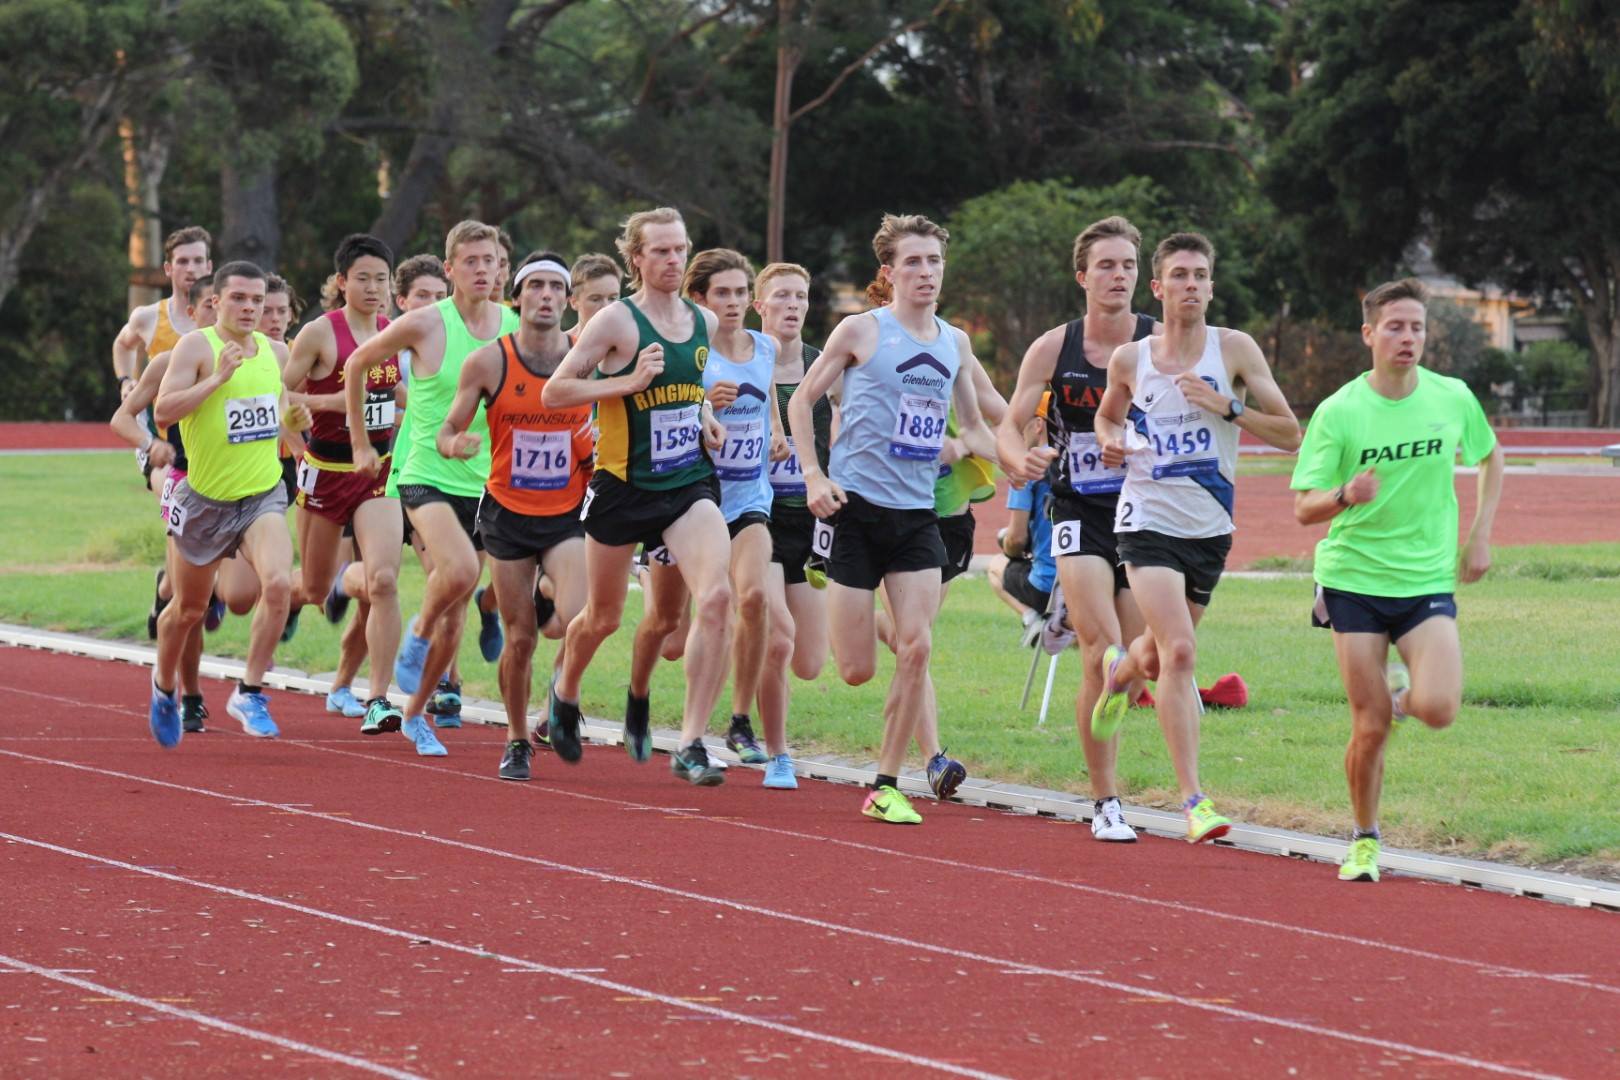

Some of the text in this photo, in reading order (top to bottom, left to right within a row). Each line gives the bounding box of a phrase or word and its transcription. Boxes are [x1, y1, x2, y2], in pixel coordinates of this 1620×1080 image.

[902, 374, 946, 391] Glenhuntly
[229, 405, 276, 430] 2981
[899, 412, 945, 439] 1884
[1153, 428, 1211, 456] 1459
[1360, 438, 1442, 465] PACER
[515, 448, 567, 470] 1716
[302, 468, 309, 487] 1
[170, 505, 182, 527] 5
[1120, 502, 1133, 526] 2
[1058, 526, 1072, 550] 6
[654, 547, 671, 566] 4
